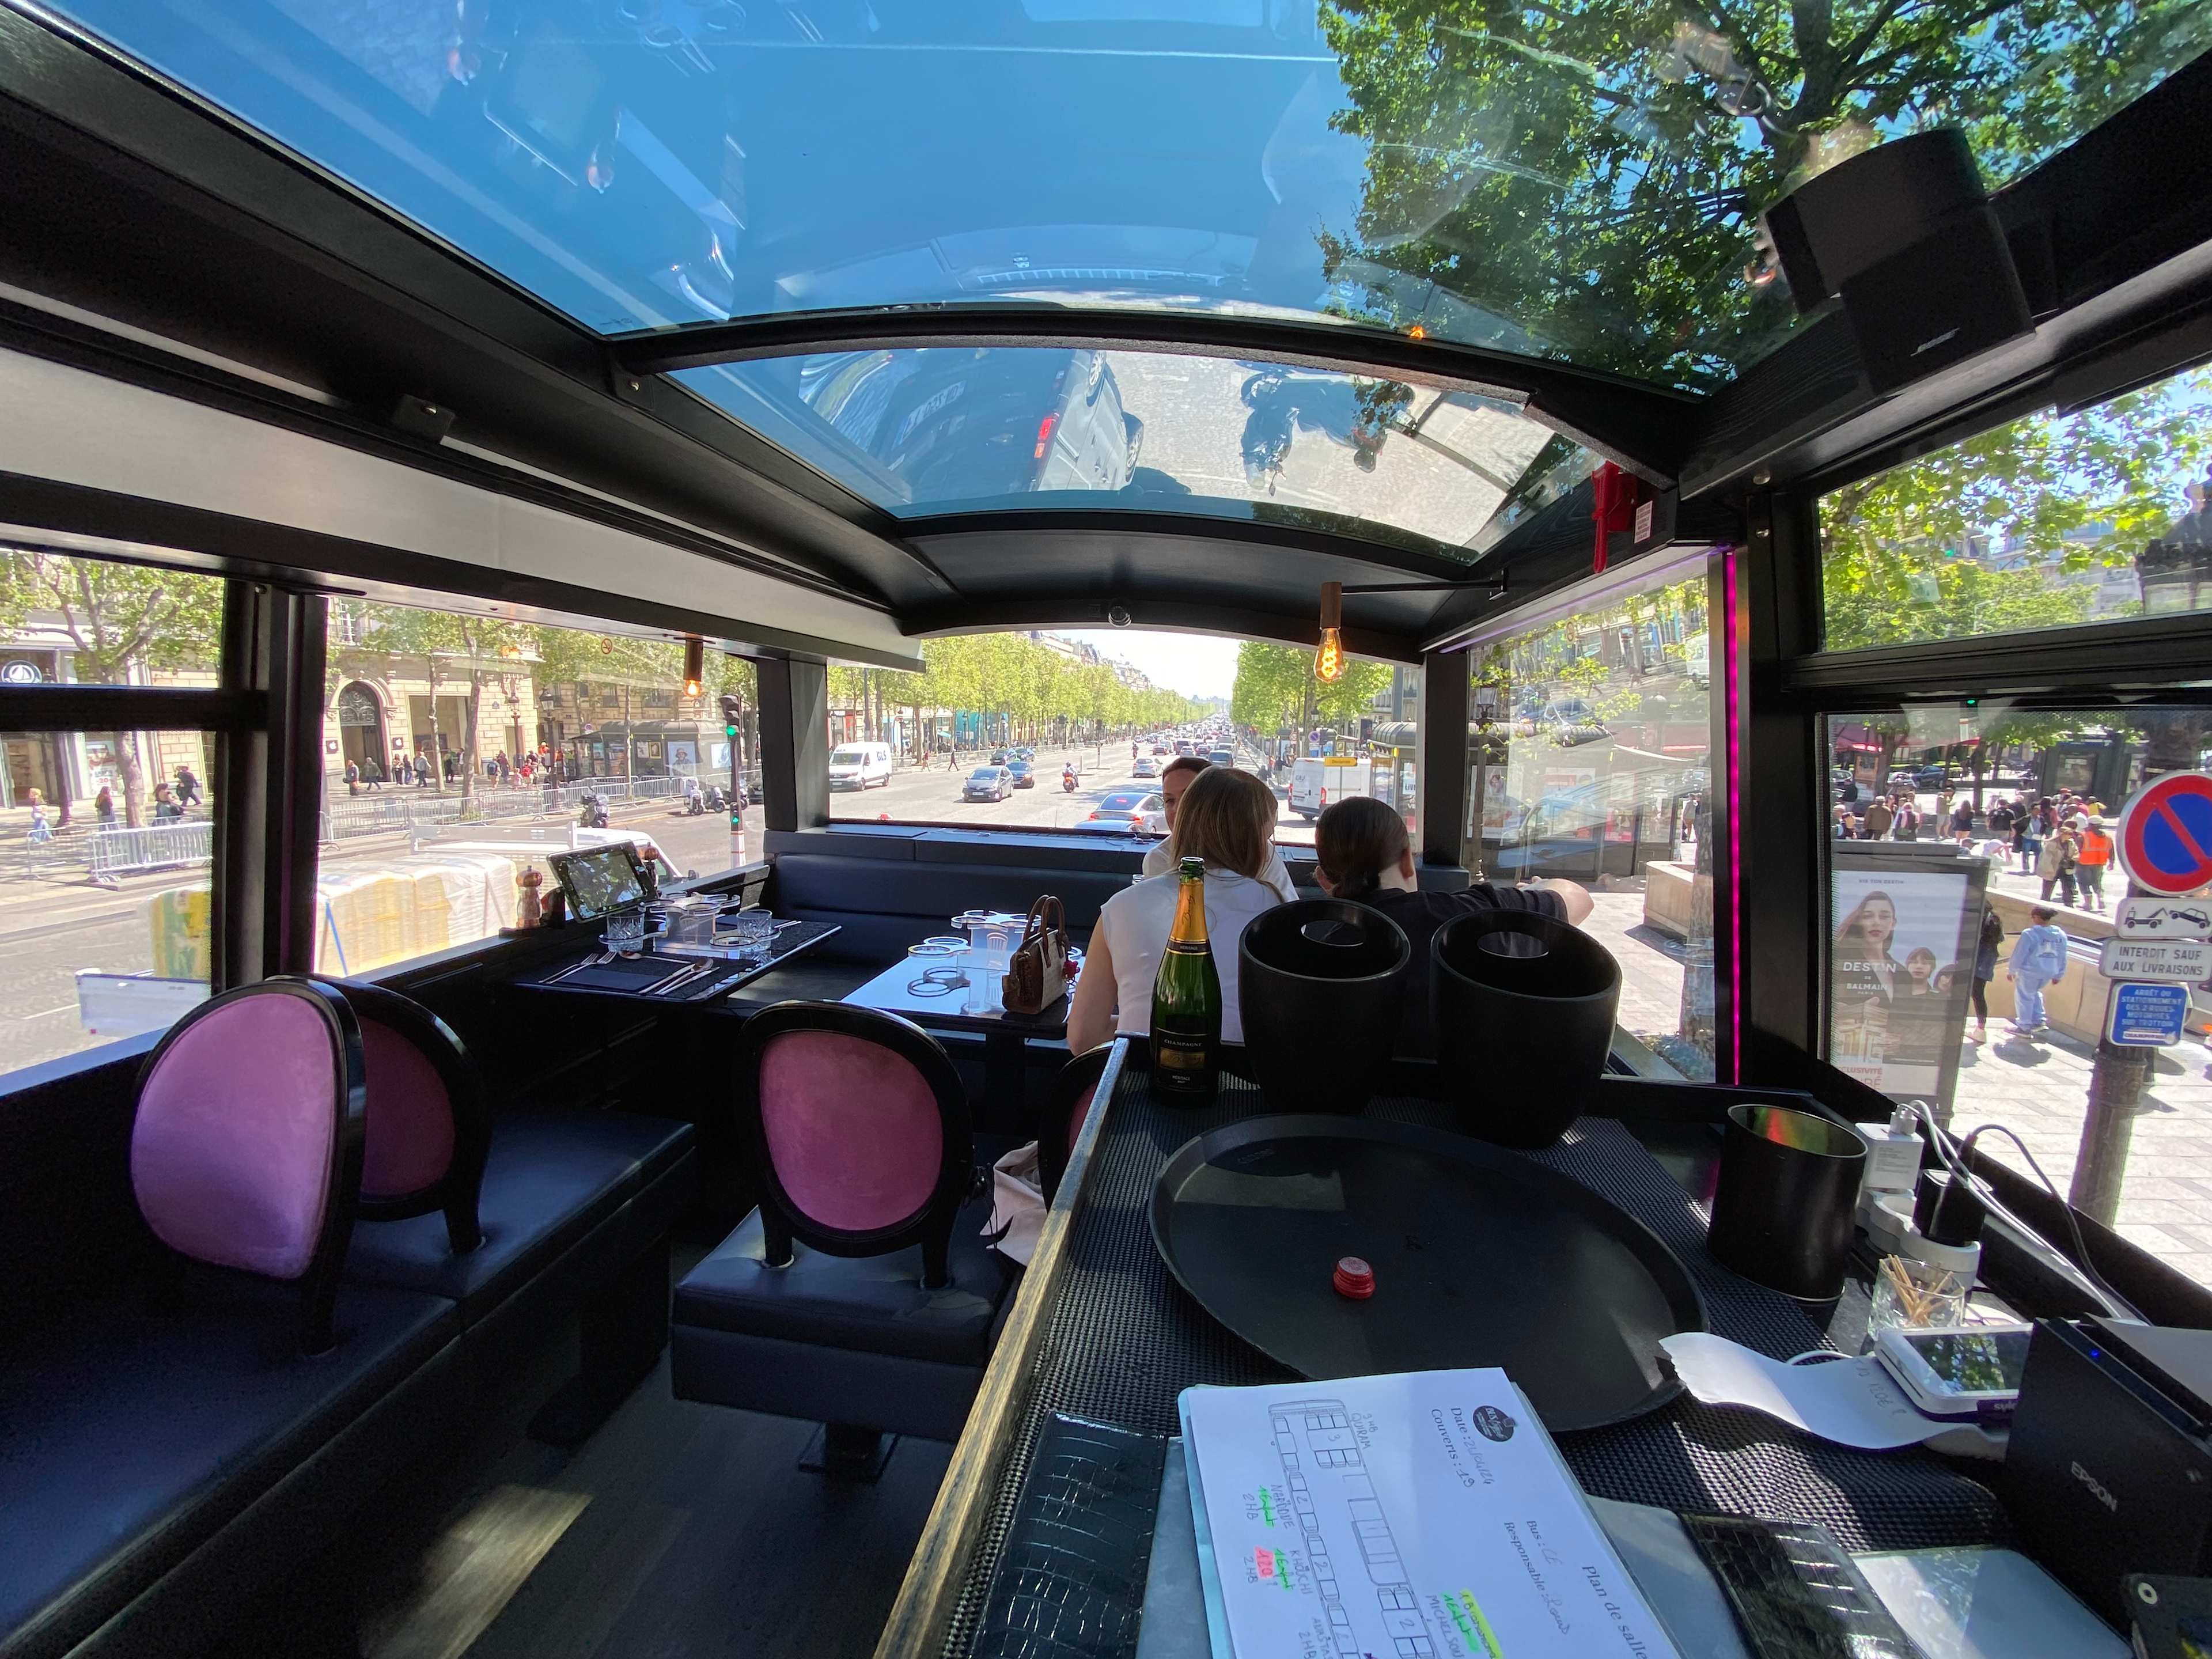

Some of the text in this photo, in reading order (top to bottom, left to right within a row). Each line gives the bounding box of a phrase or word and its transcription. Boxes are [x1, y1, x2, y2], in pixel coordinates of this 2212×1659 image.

[877, 749, 887, 762] GLS
[2119, 946, 2202, 960] INTERDIT SAUF
[2112, 961, 2203, 976] AUX LIVRAISONS
[1164, 1039, 1202, 1047] CHAMPAGNE
[1450, 1407, 1468, 1433] Date
[1431, 1408, 1459, 1460] Couverts
[1456, 1468, 1475, 1488] 19
[2071, 1461, 2118, 1512] EPSON
[1527, 1521, 1542, 1540] Bus
[1504, 1522, 1545, 1591] Responsable
[1581, 1566, 1648, 1659] Plan de salle
[1399, 1619, 1415, 1631] 2
